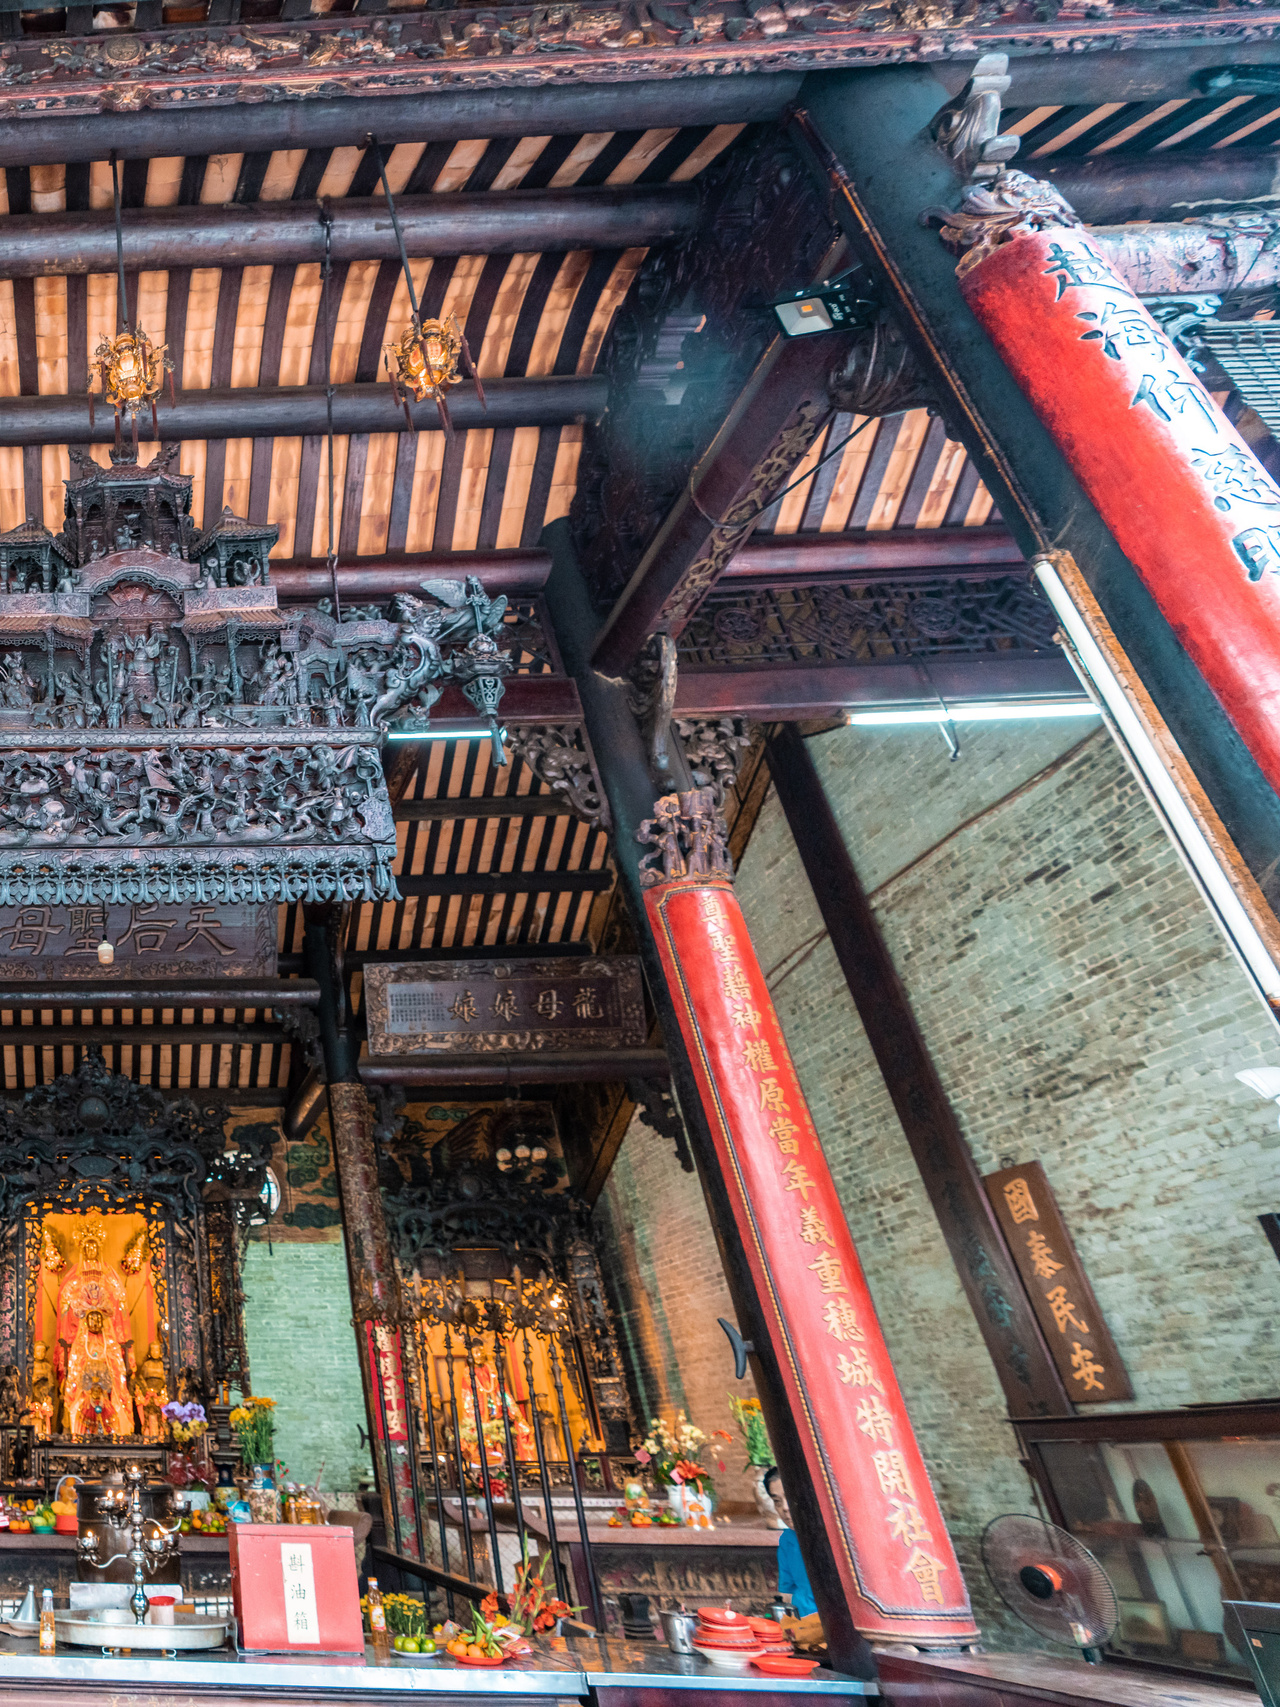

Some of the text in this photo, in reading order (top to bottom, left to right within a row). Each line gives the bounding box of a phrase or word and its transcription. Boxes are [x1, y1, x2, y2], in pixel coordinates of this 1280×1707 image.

[447, 987, 605, 1023] 龍母娘娘
[1002, 1177, 1106, 1391] 國泰民安
